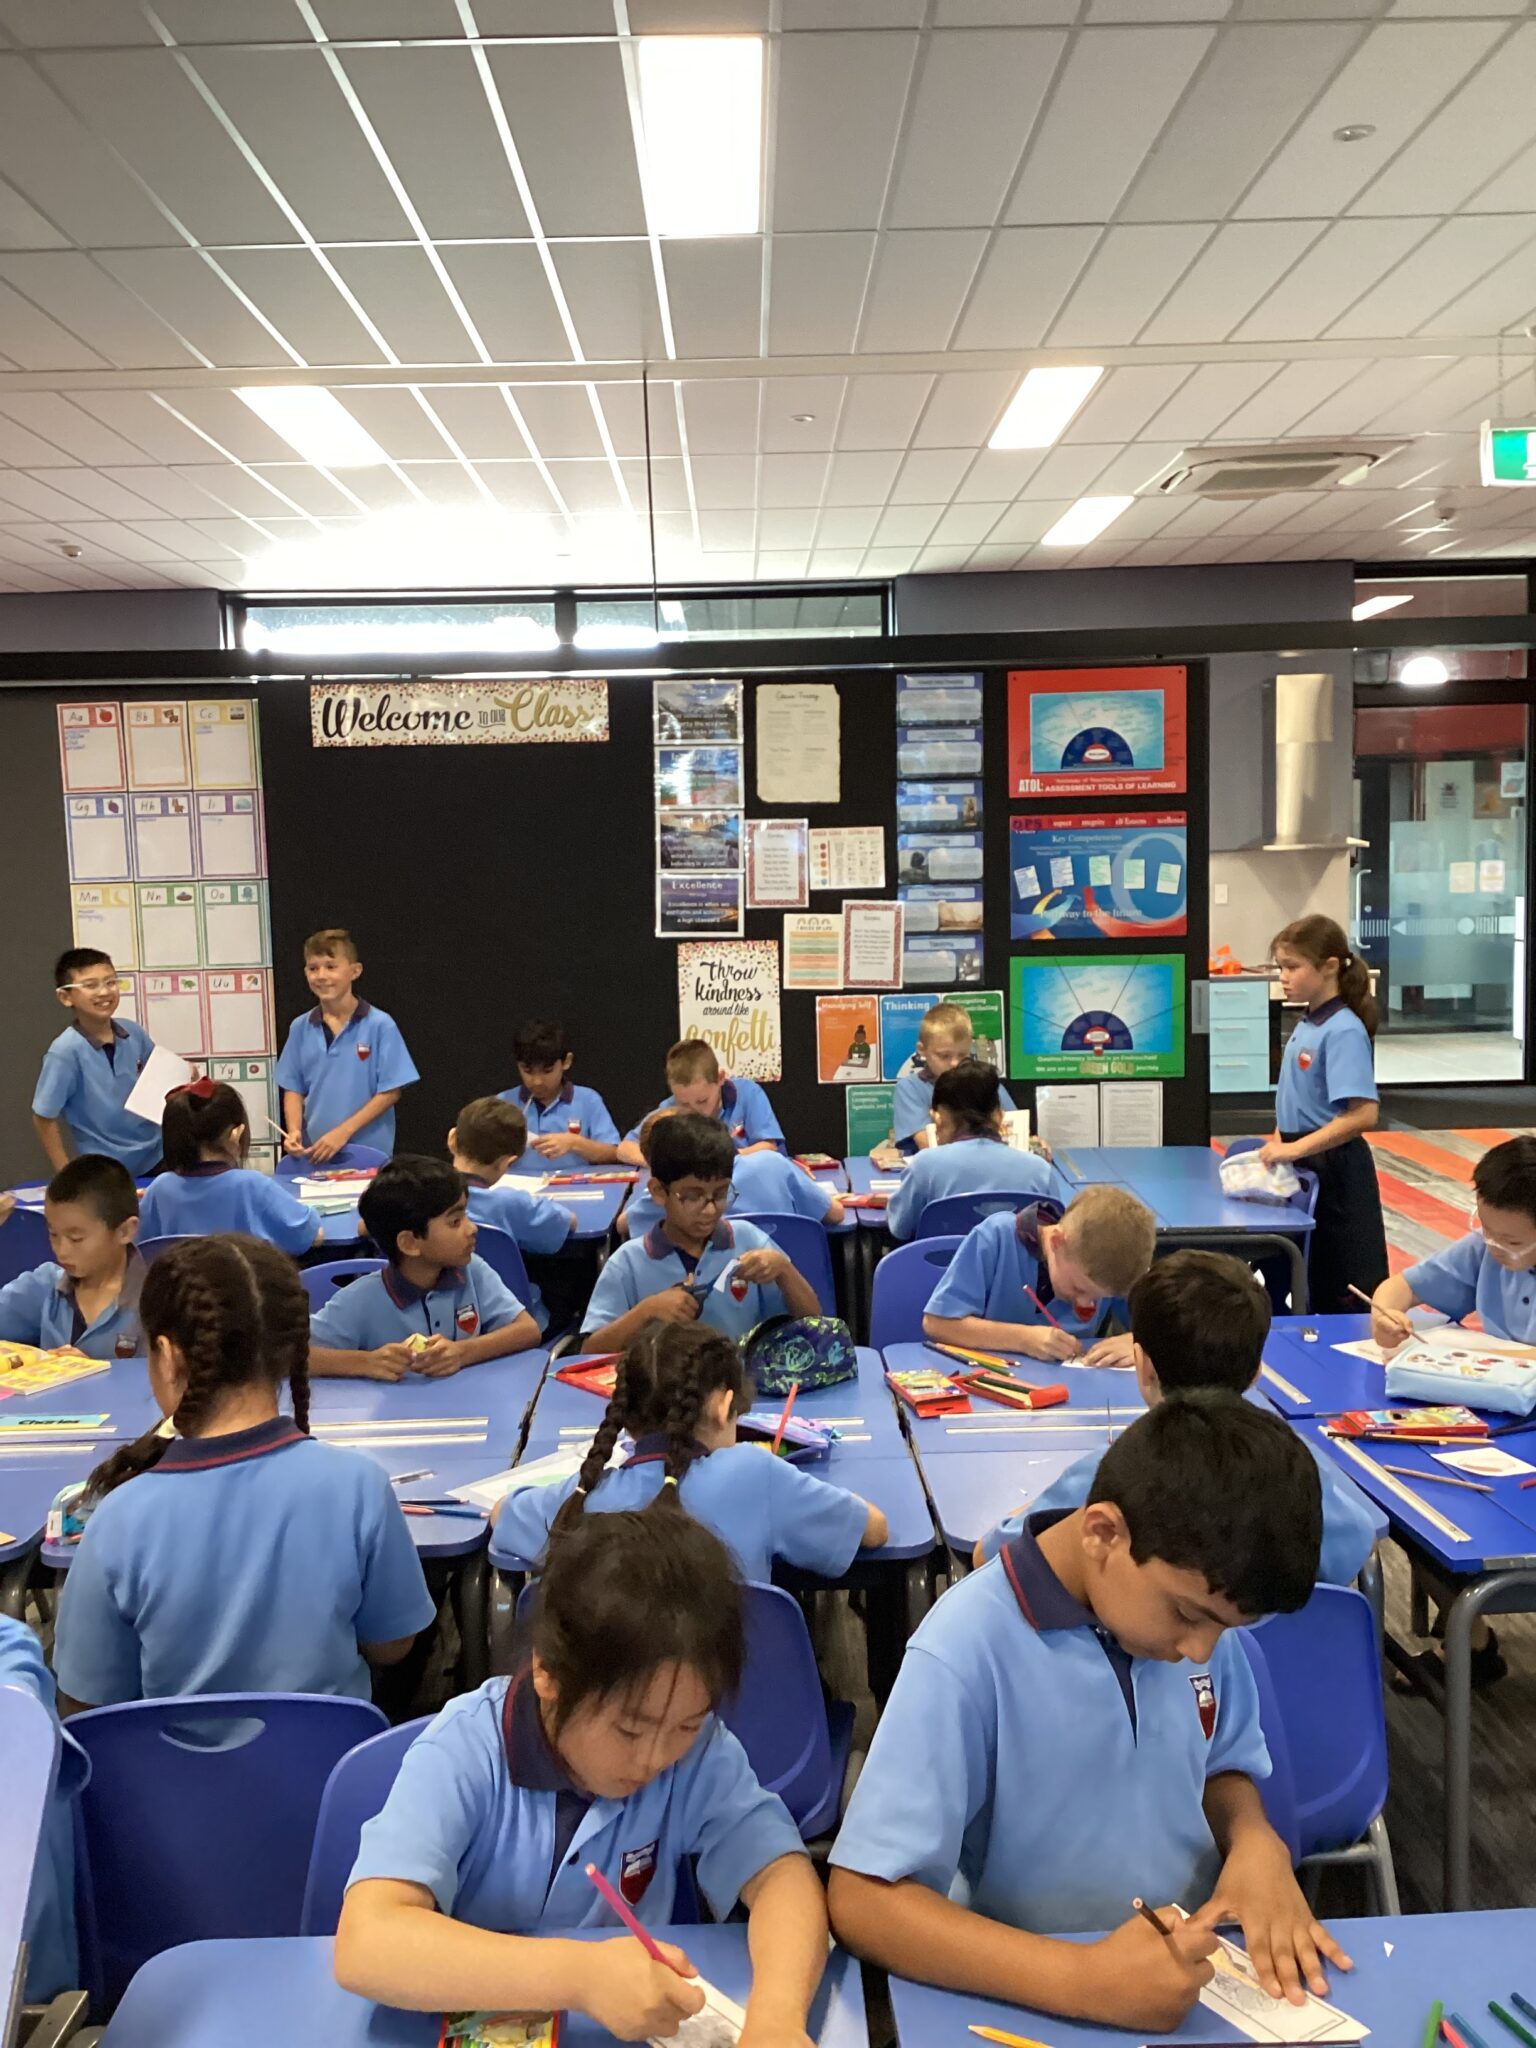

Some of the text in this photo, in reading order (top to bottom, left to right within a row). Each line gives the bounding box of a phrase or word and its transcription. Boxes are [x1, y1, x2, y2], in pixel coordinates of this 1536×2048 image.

[68, 708, 83, 722] Aa
[322, 694, 473, 738] Welcome
[478, 710, 488, 722] TO
[494, 688, 595, 732] Class
[1019, 778, 1177, 793] ATOL: ASSESSMENT TOOLS OF LEARNING
[1052, 834, 1066, 844] Key
[671, 881, 723, 890] Excellence
[700, 960, 758, 981] Throw
[695, 976, 763, 1003] kindness
[702, 1002, 750, 1016] around like
[884, 1000, 930, 1012] Thinking
[685, 1008, 776, 1070] confetti
